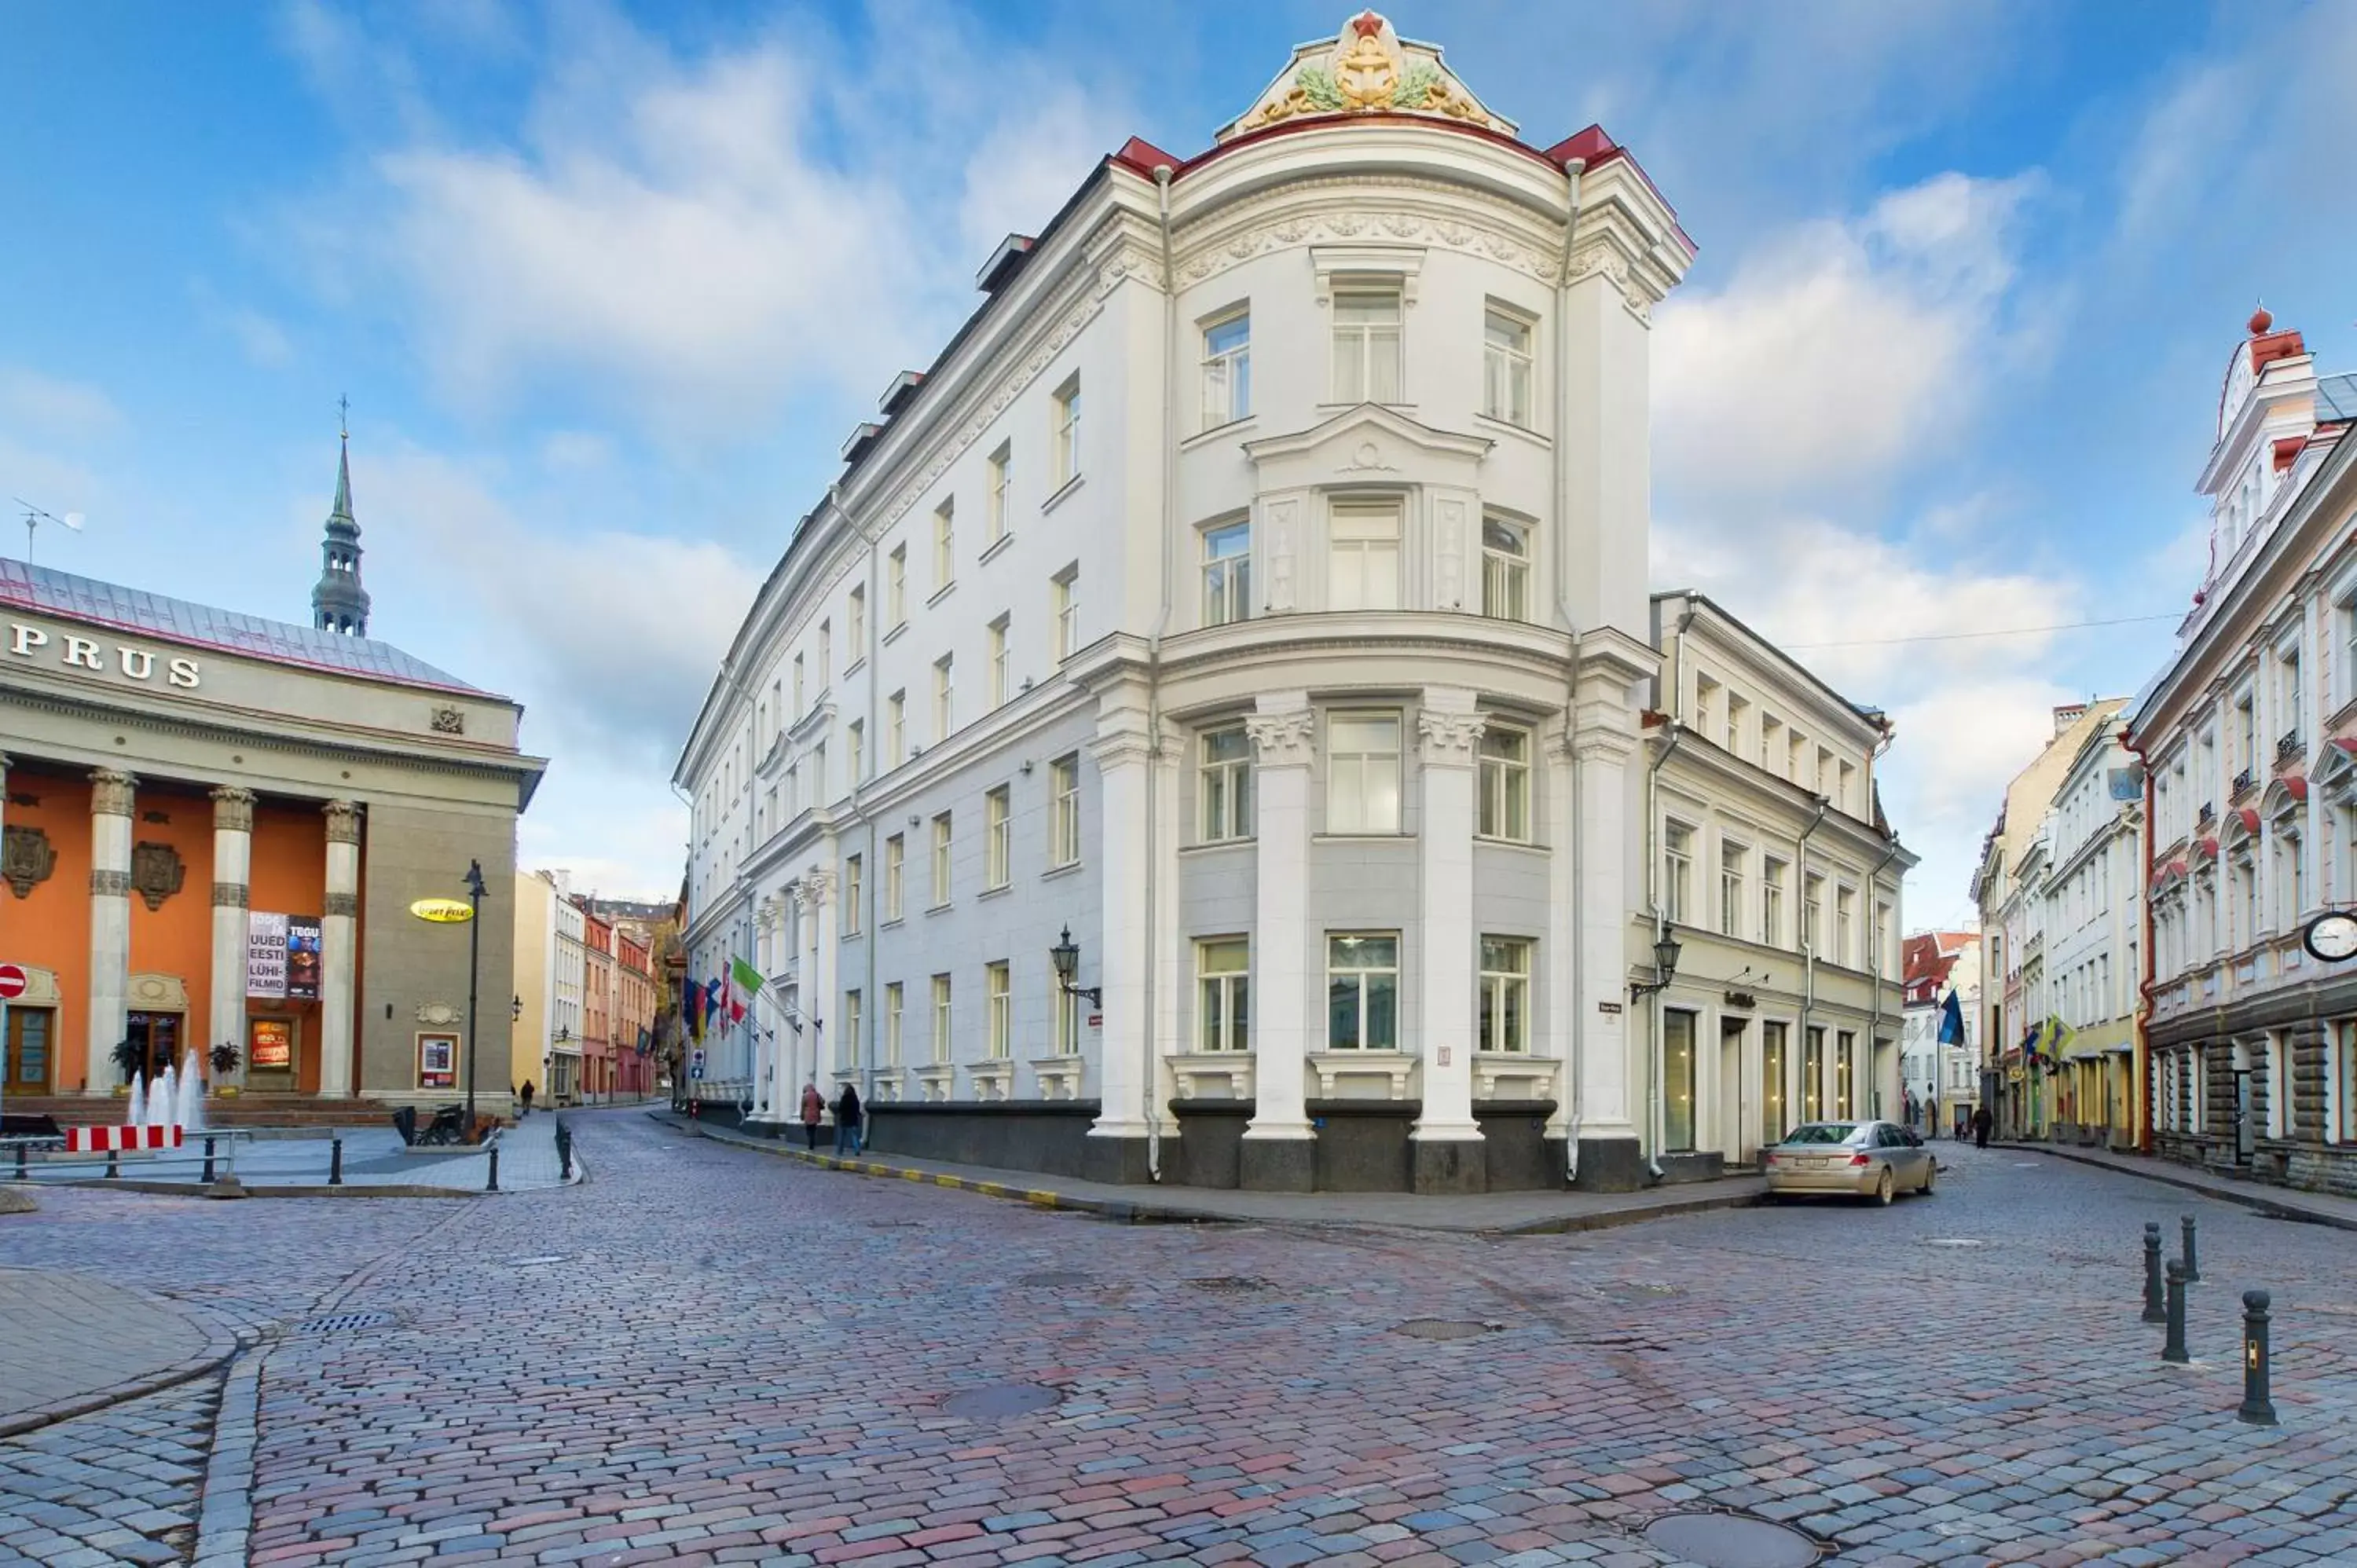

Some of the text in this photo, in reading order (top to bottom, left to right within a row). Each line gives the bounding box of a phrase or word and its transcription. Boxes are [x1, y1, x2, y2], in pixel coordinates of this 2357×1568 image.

[10, 623, 200, 687] PRUS
[290, 926, 319, 937] TEGU
[251, 934, 284, 947] UUED
[250, 948, 284, 961] EESTI
[249, 964, 284, 976] LÜHI-
[248, 978, 284, 989] FILMID
